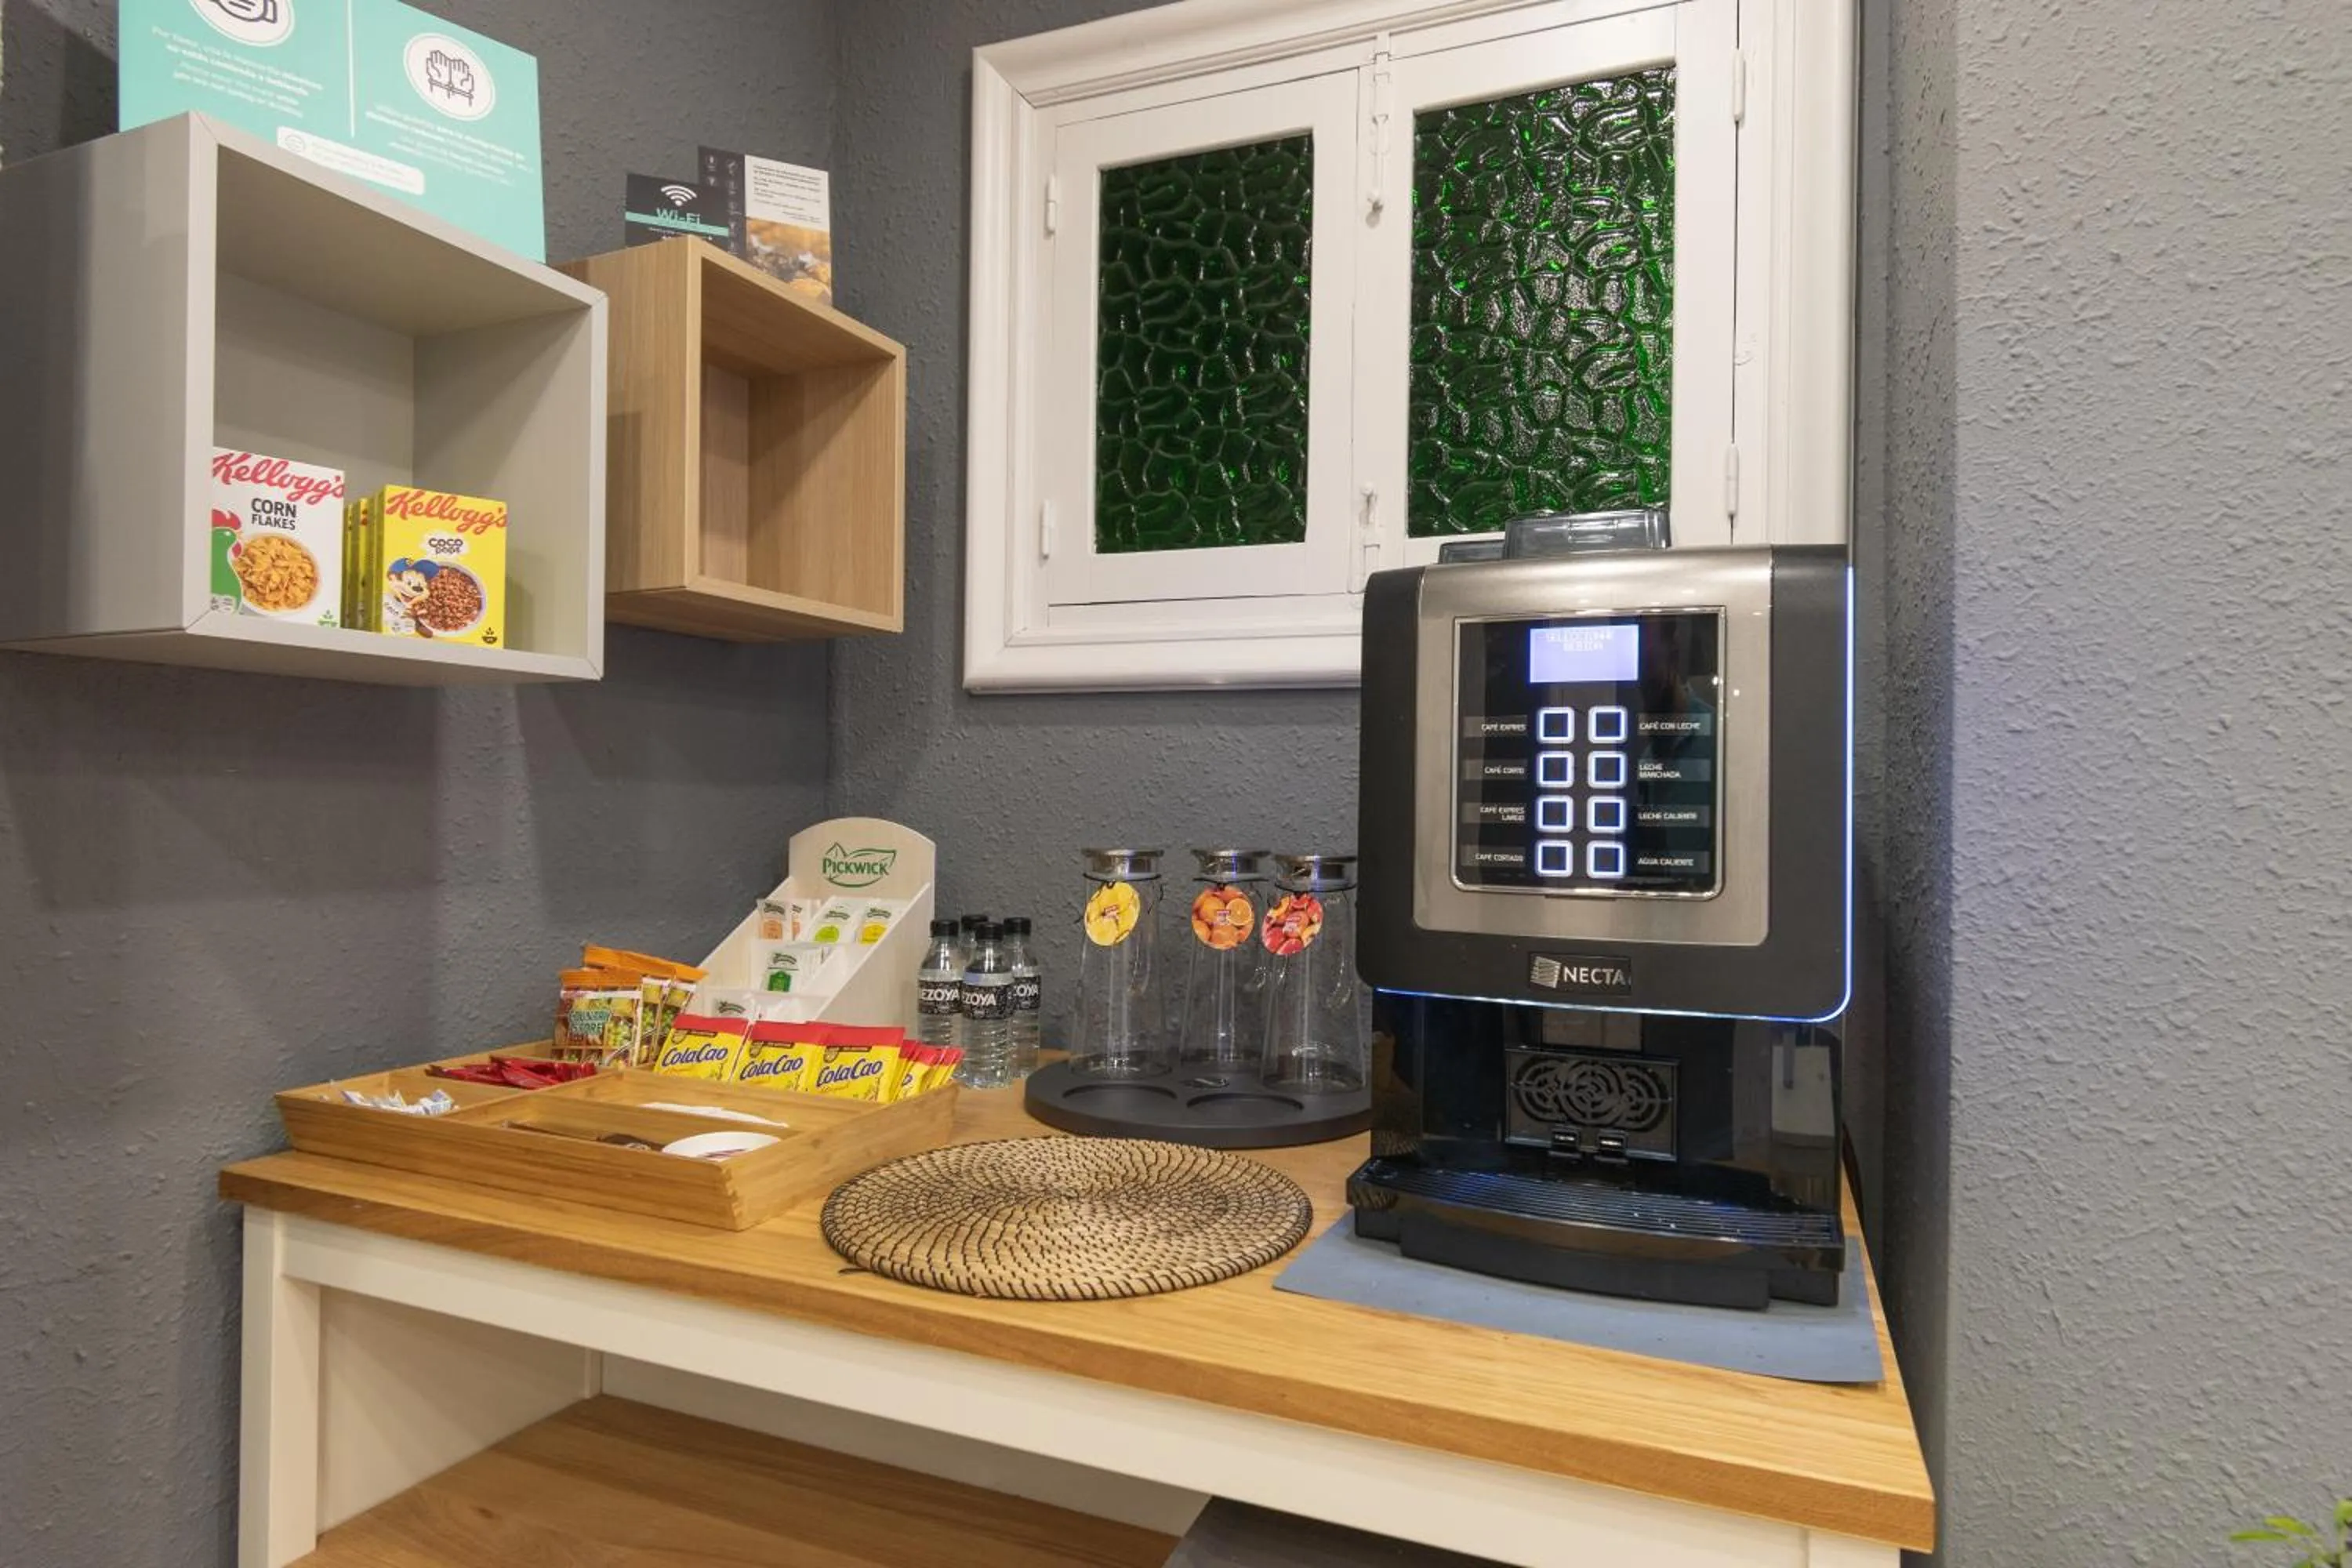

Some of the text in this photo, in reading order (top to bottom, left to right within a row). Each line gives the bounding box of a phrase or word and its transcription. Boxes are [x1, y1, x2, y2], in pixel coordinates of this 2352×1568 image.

[656, 207, 700, 225] Wi-Fi
[212, 452, 345, 505] Kellogg's
[251, 498, 296, 517] CORN
[385, 489, 508, 535] Kellogg's
[251, 514, 296, 531] FLAKES
[1563, 966, 1626, 985] NECTA
[921, 988, 960, 1001] EZOYA
[963, 992, 996, 1006] ZOYA
[662, 1043, 728, 1067] ColaCao
[739, 1054, 804, 1080] ColaCao
[815, 1058, 883, 1087] ColaCao
